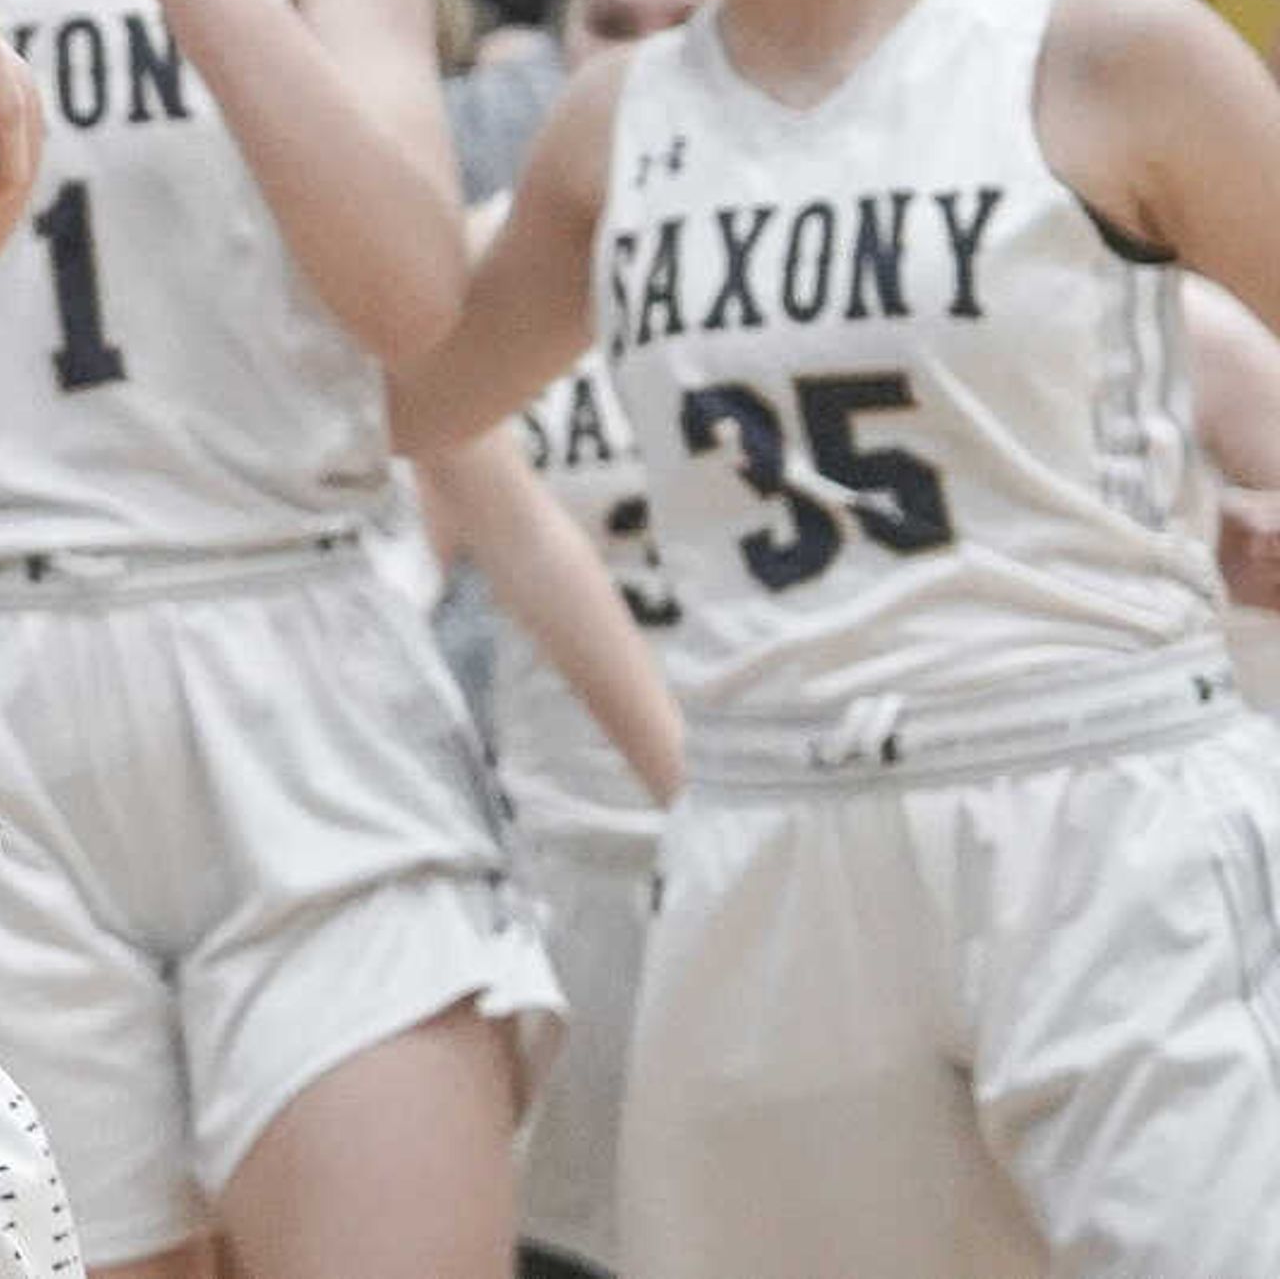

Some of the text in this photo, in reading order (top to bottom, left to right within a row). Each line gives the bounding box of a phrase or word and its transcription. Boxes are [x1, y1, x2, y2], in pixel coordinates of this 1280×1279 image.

[13, 13, 190, 130] ON
[33, 179, 129, 392] 1
[609, 187, 1003, 361] SAXONY
[678, 369, 956, 592] 35
